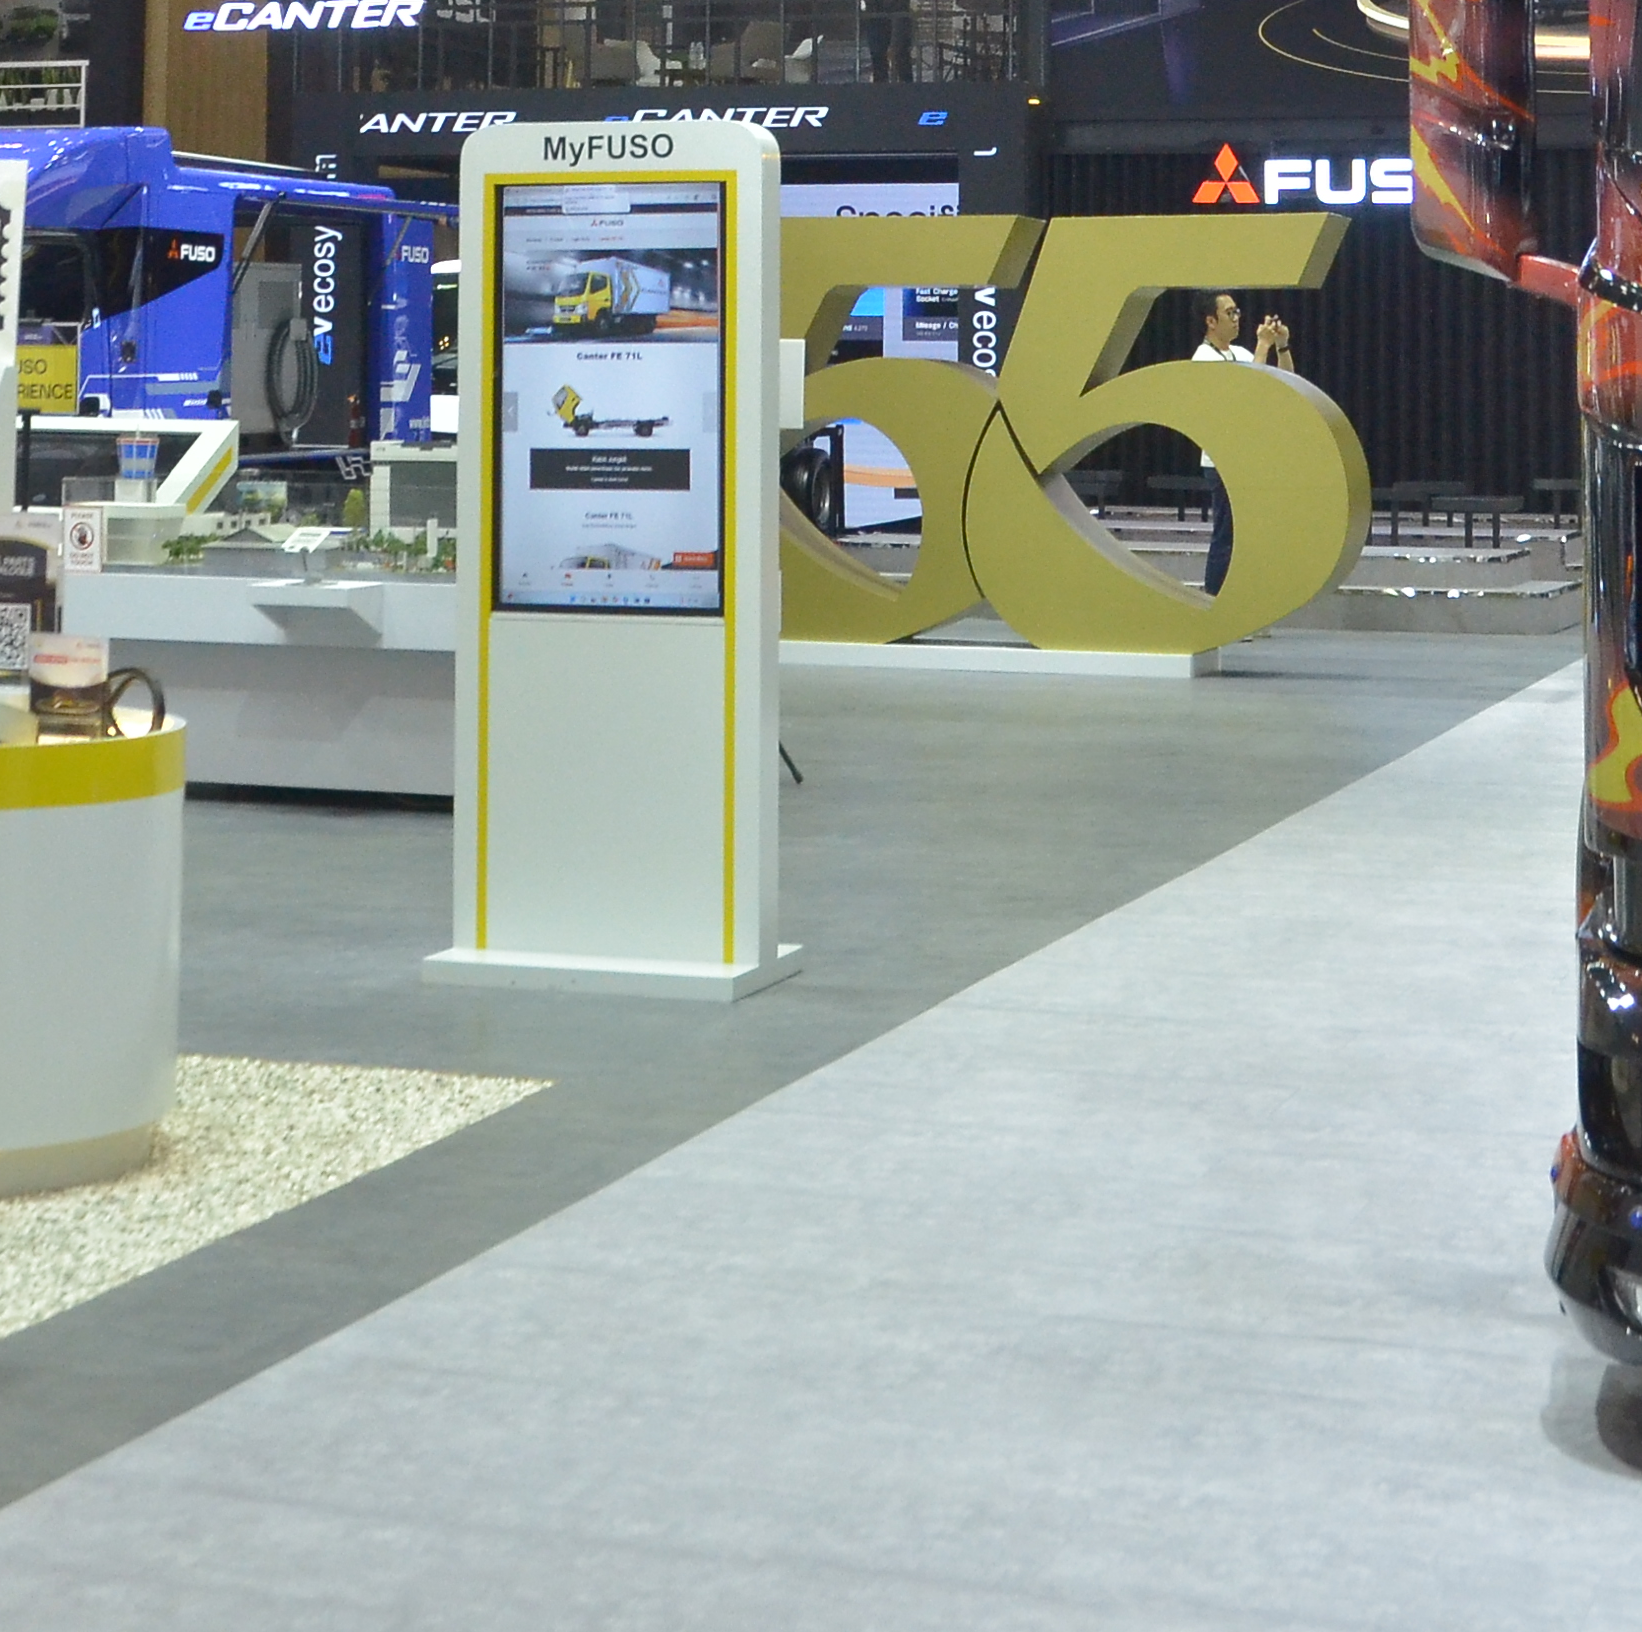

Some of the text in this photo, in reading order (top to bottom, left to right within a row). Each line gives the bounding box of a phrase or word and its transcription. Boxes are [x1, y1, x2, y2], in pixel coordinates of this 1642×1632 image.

[359, 111, 517, 134] ANTER
[542, 133, 674, 167] MyFUSO
[1263, 158, 1414, 205] FUS
[179, 243, 217, 263] FUSO
[401, 244, 430, 264] FUSO
[18, 359, 48, 375] USO
[18, 383, 74, 400] RIENCE
